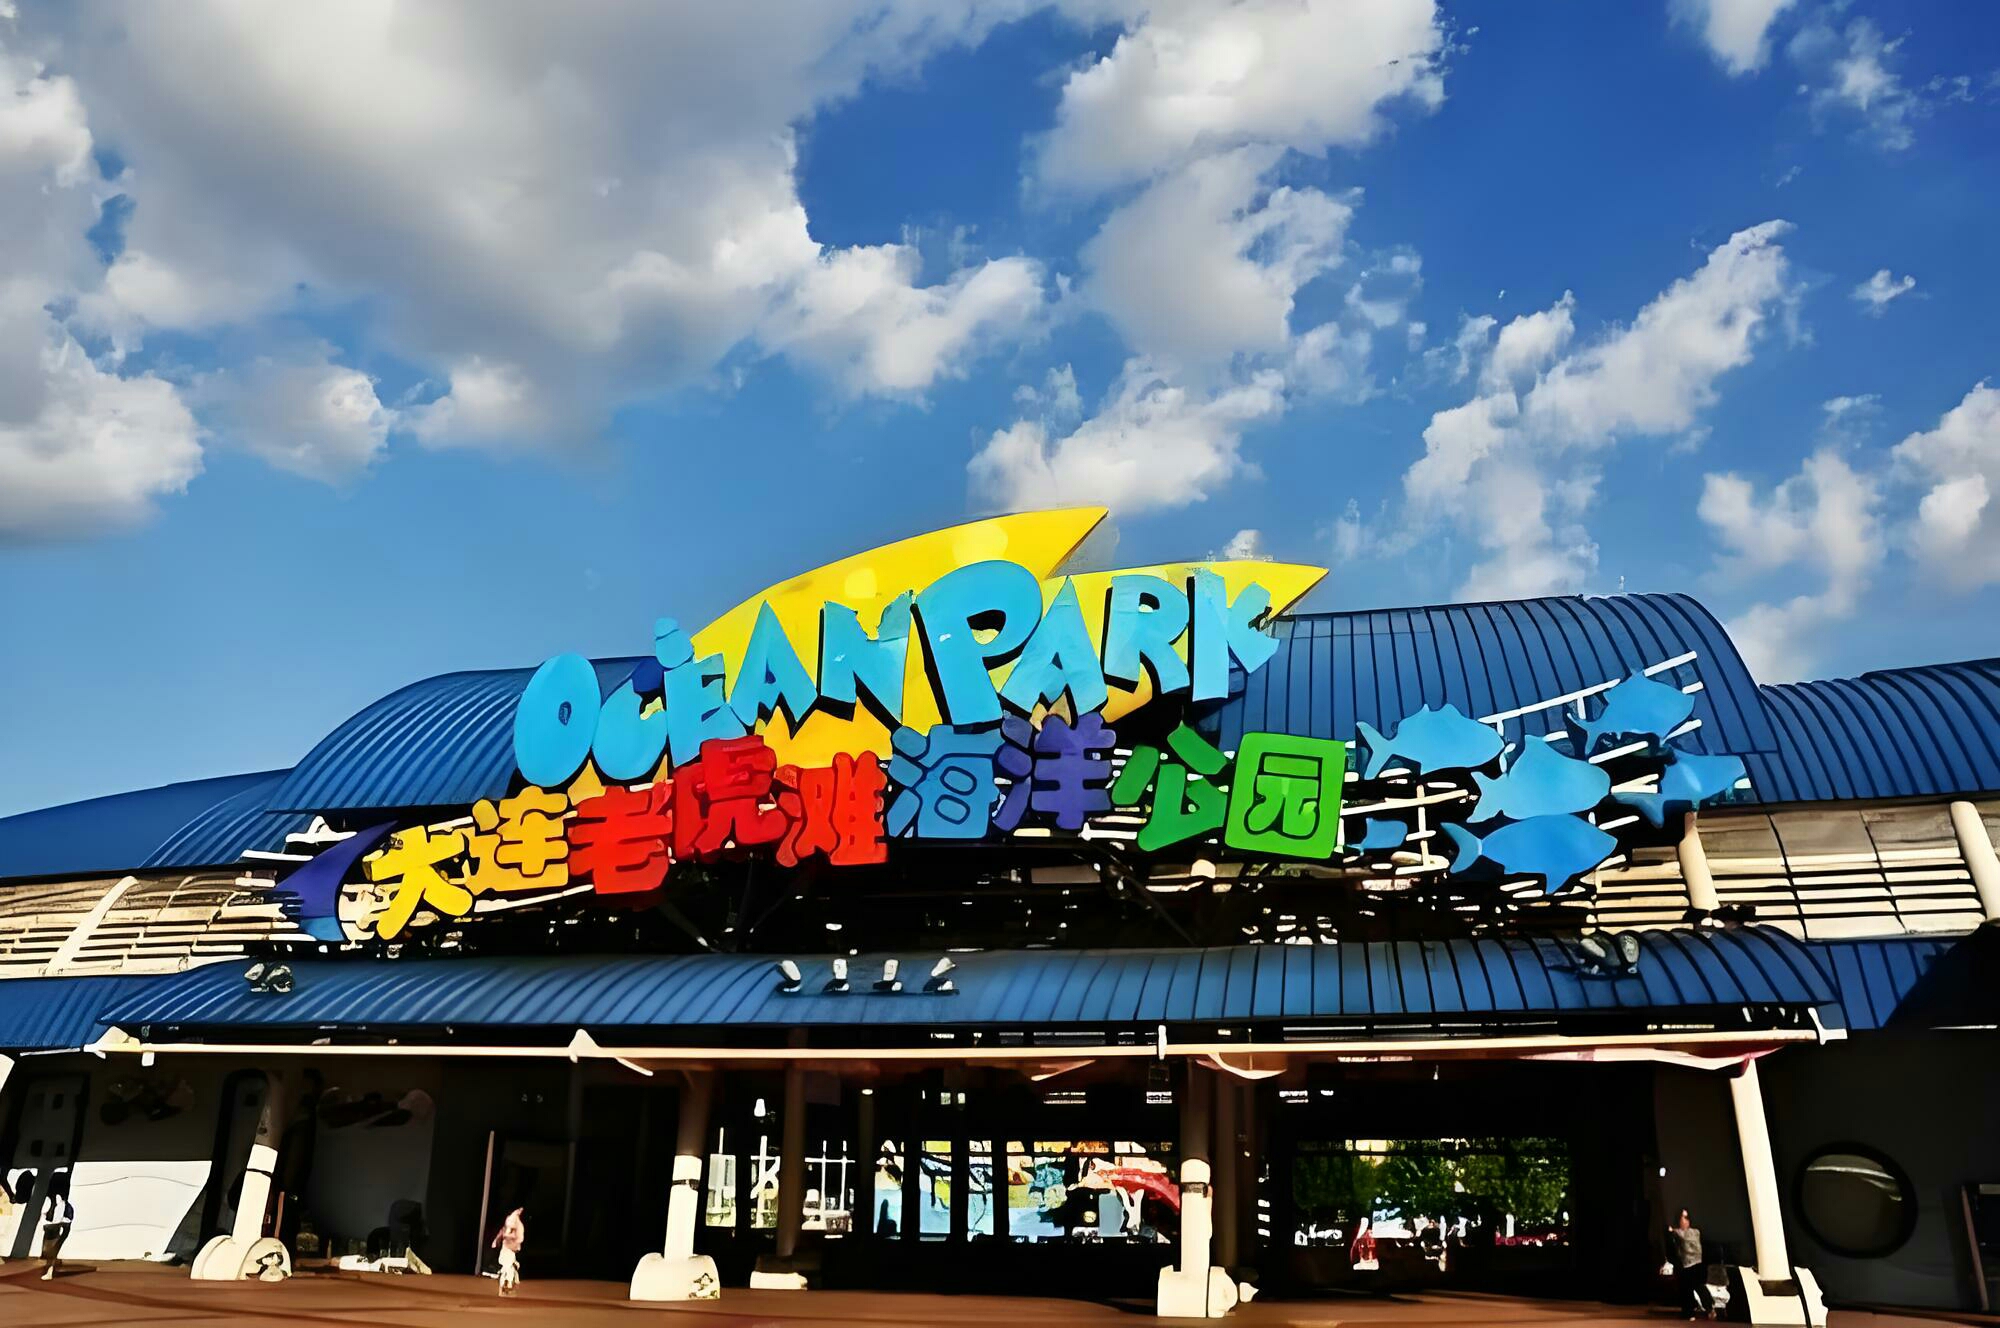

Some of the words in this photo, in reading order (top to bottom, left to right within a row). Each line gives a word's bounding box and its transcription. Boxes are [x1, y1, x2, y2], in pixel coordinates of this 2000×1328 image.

[513, 589, 914, 787] OCEAN
[913, 559, 1280, 726] PARK
[363, 710, 1346, 940] 大连老虎滩海洋公园
